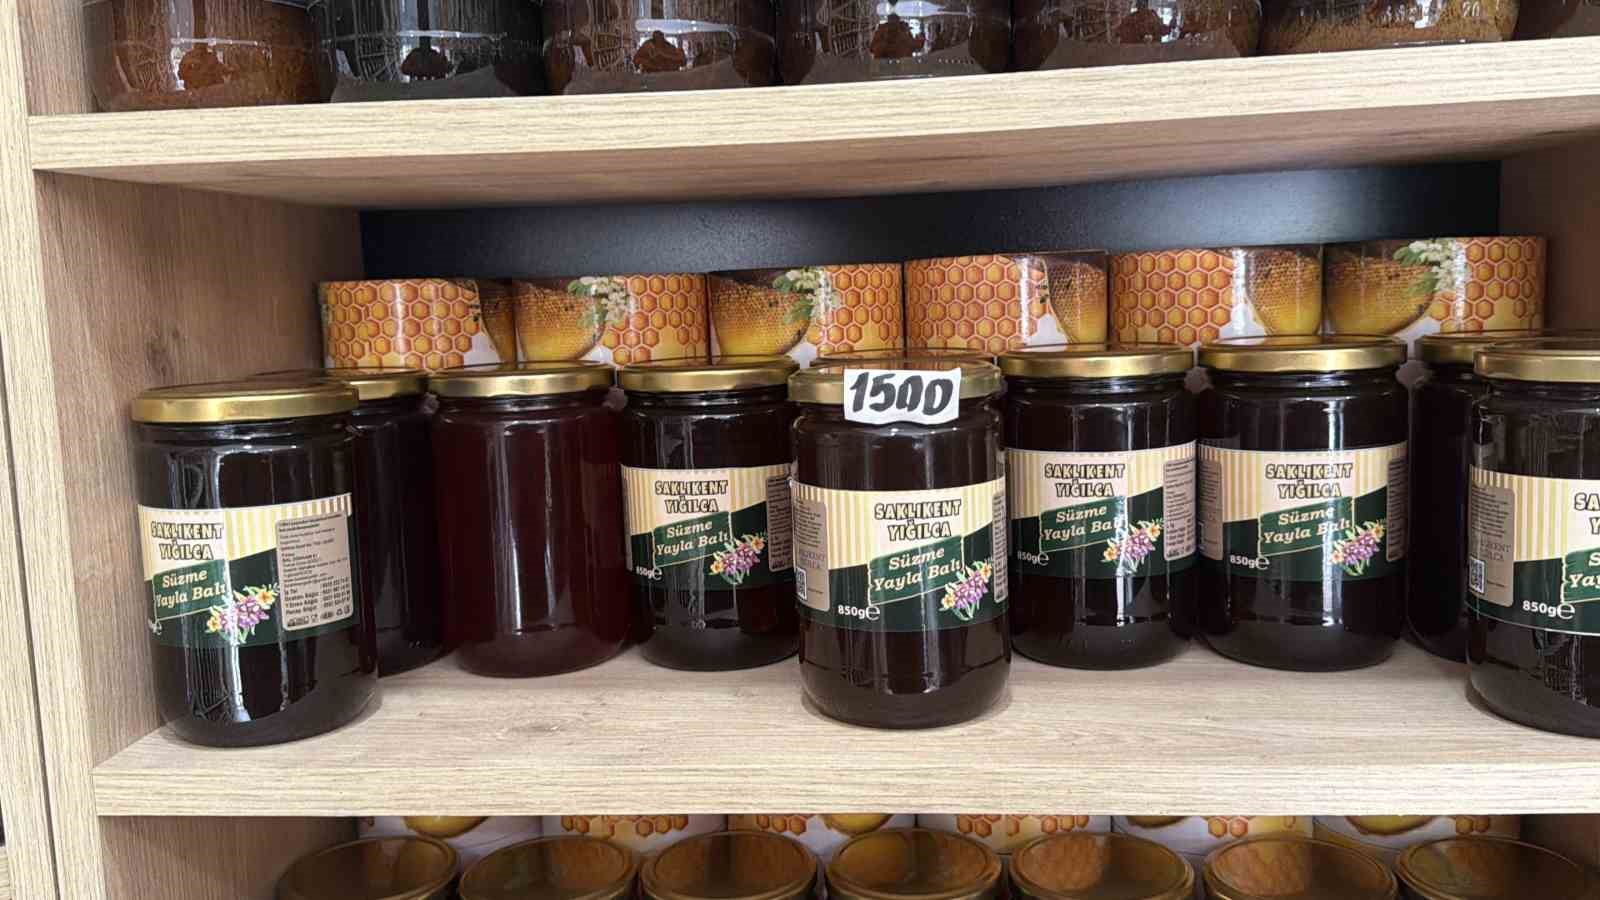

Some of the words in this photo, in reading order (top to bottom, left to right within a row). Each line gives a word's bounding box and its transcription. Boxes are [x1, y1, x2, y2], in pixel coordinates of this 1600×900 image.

[850, 372, 953, 415] 1500
[1044, 463, 1125, 479] SAKLIKENT
[1265, 463, 1352, 479] SAKLIKENT
[655, 480, 728, 495] SAKLIKENT
[1055, 480, 1114, 498] YIĞILCA
[1278, 479, 1342, 499] YIĞILCA
[664, 495, 719, 513] YIĞILCA
[874, 499, 962, 521] SAKLIKENT
[1056, 505, 1107, 523] Süzme
[1278, 507, 1335, 526] Süzme
[666, 520, 713, 538] Süzme
[888, 520, 951, 542] YIĞILCA
[1043, 526, 1085, 542] Yayla
[1263, 528, 1311, 545] Yayla
[656, 541, 693, 556] Yayla
[889, 547, 945, 571] Süzme
[162, 569, 208, 589] Süzme
[873, 571, 922, 592] Yayla
[927, 559, 962, 579] Balı
